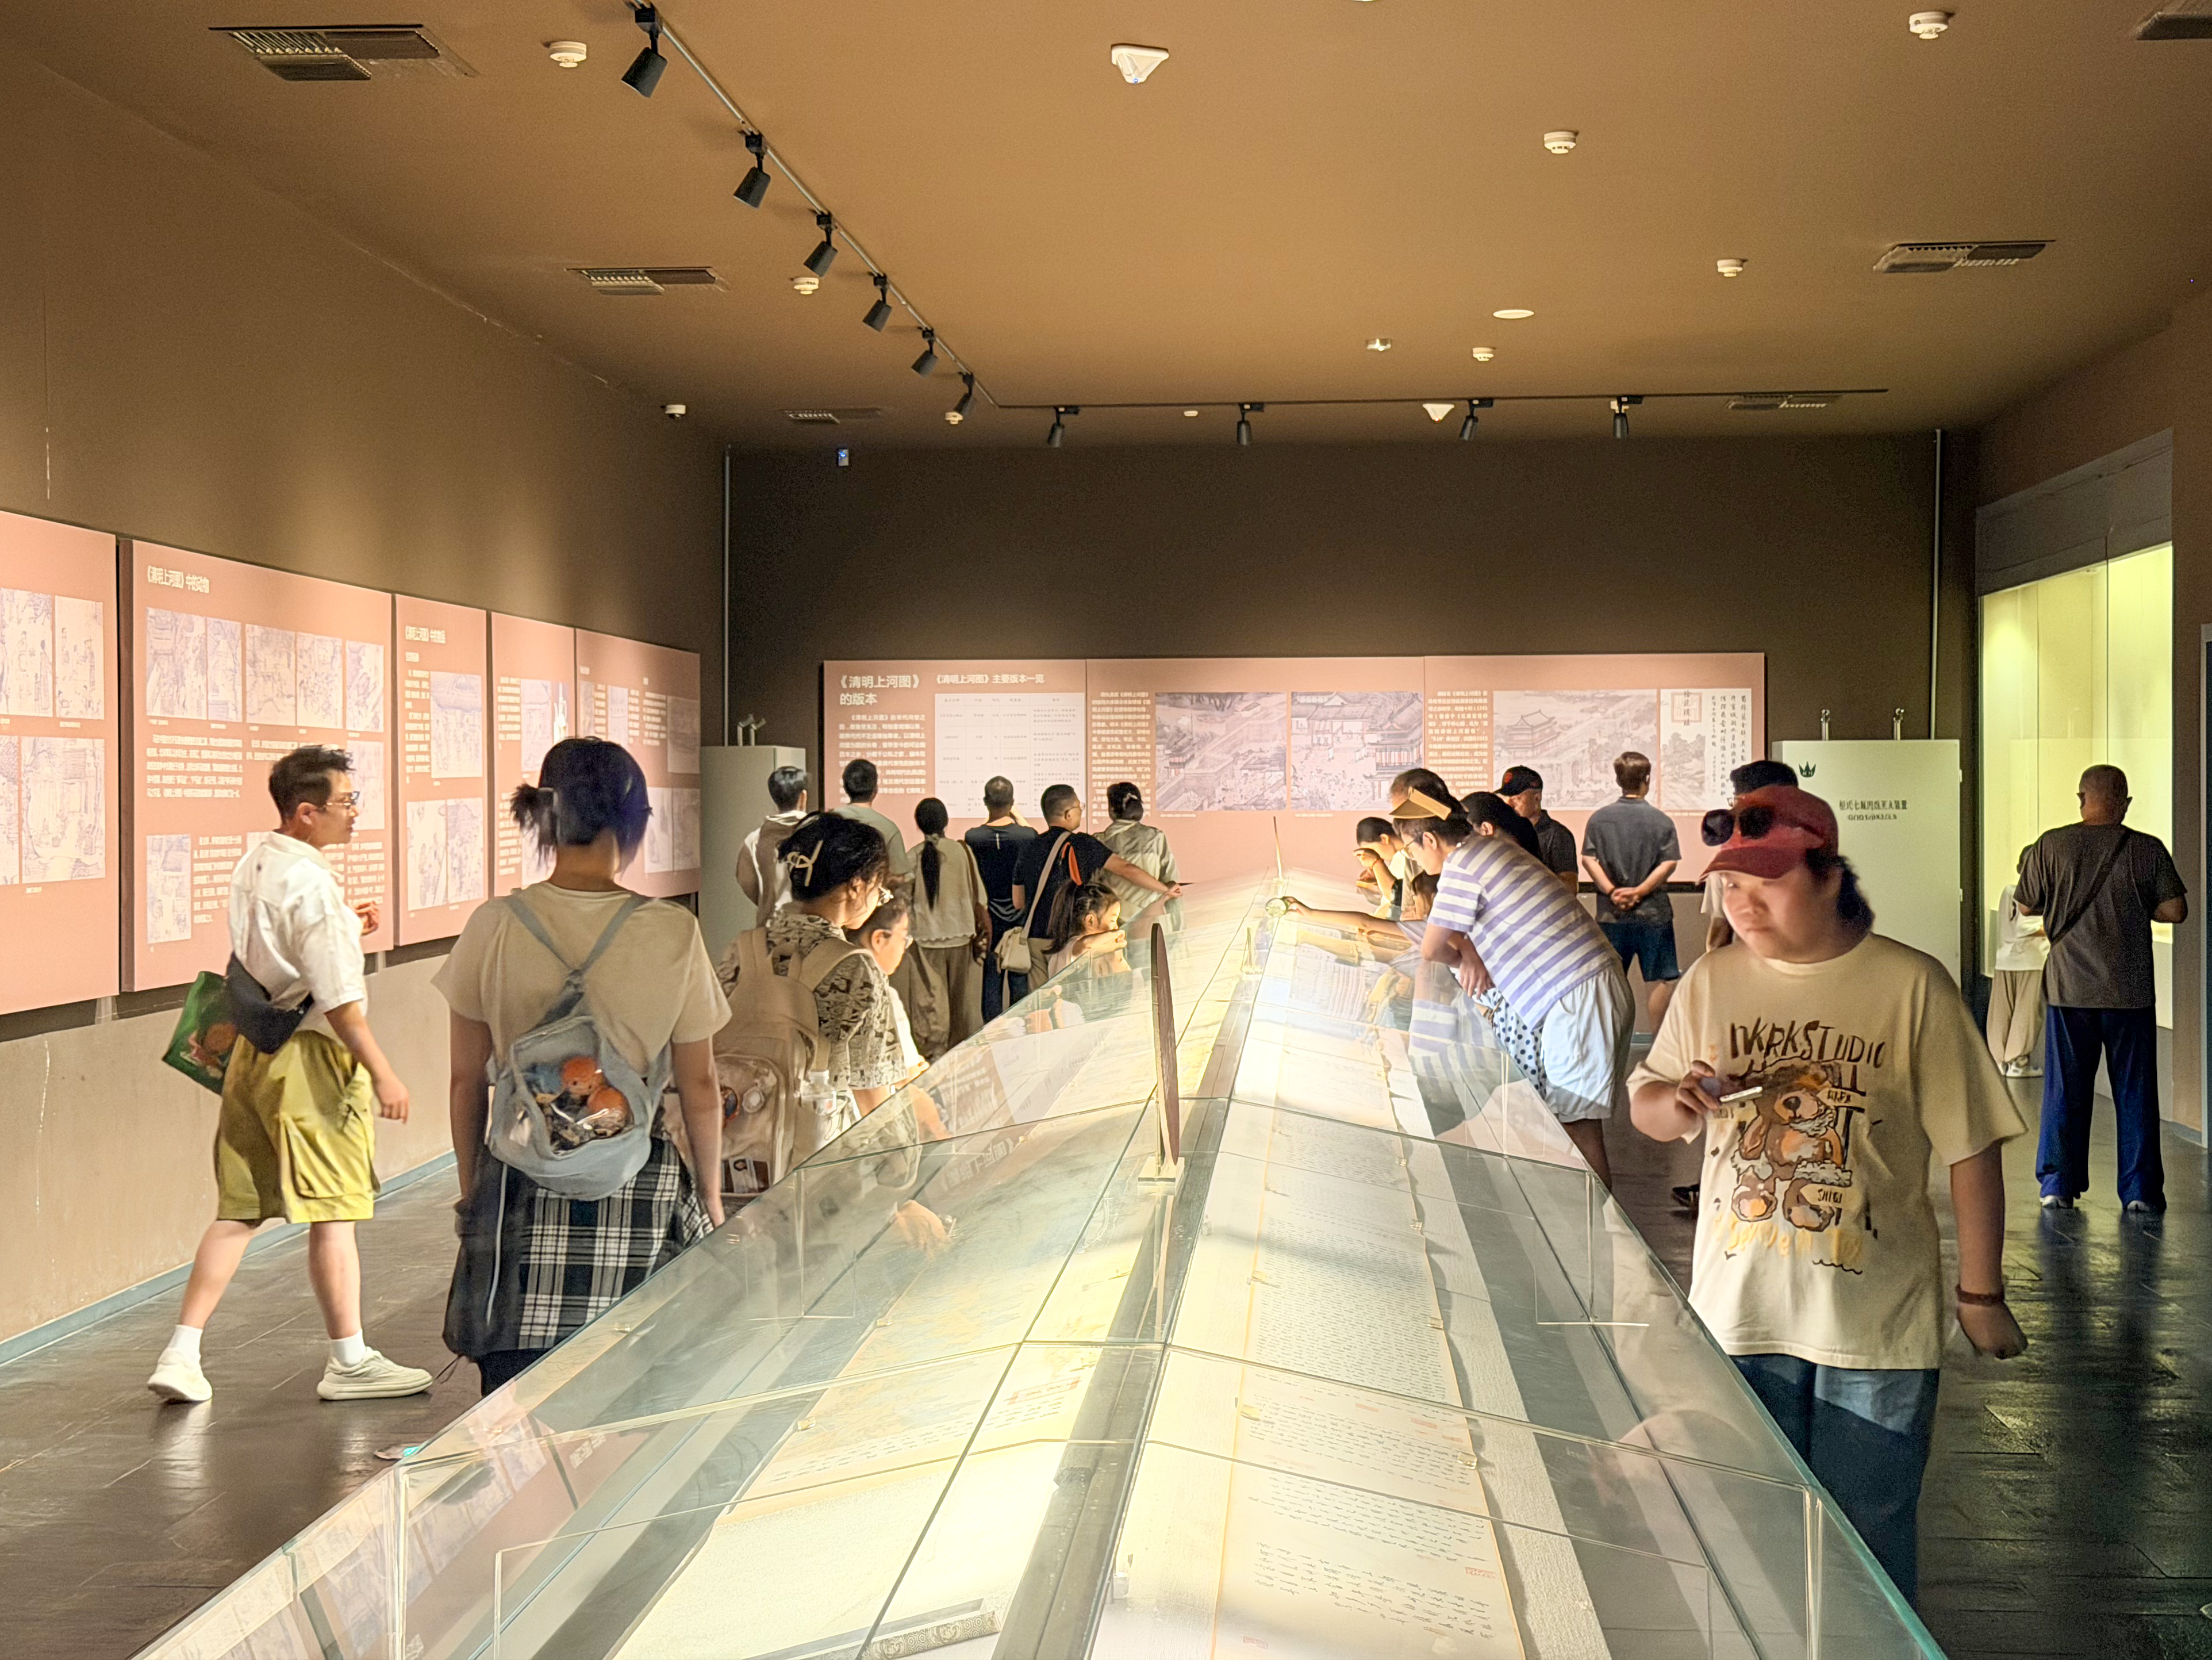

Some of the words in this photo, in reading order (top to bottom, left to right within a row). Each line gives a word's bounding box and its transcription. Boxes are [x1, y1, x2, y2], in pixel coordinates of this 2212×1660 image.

[840, 674, 919, 688] 《清明上河图》
[840, 692, 877, 706] 的版本
